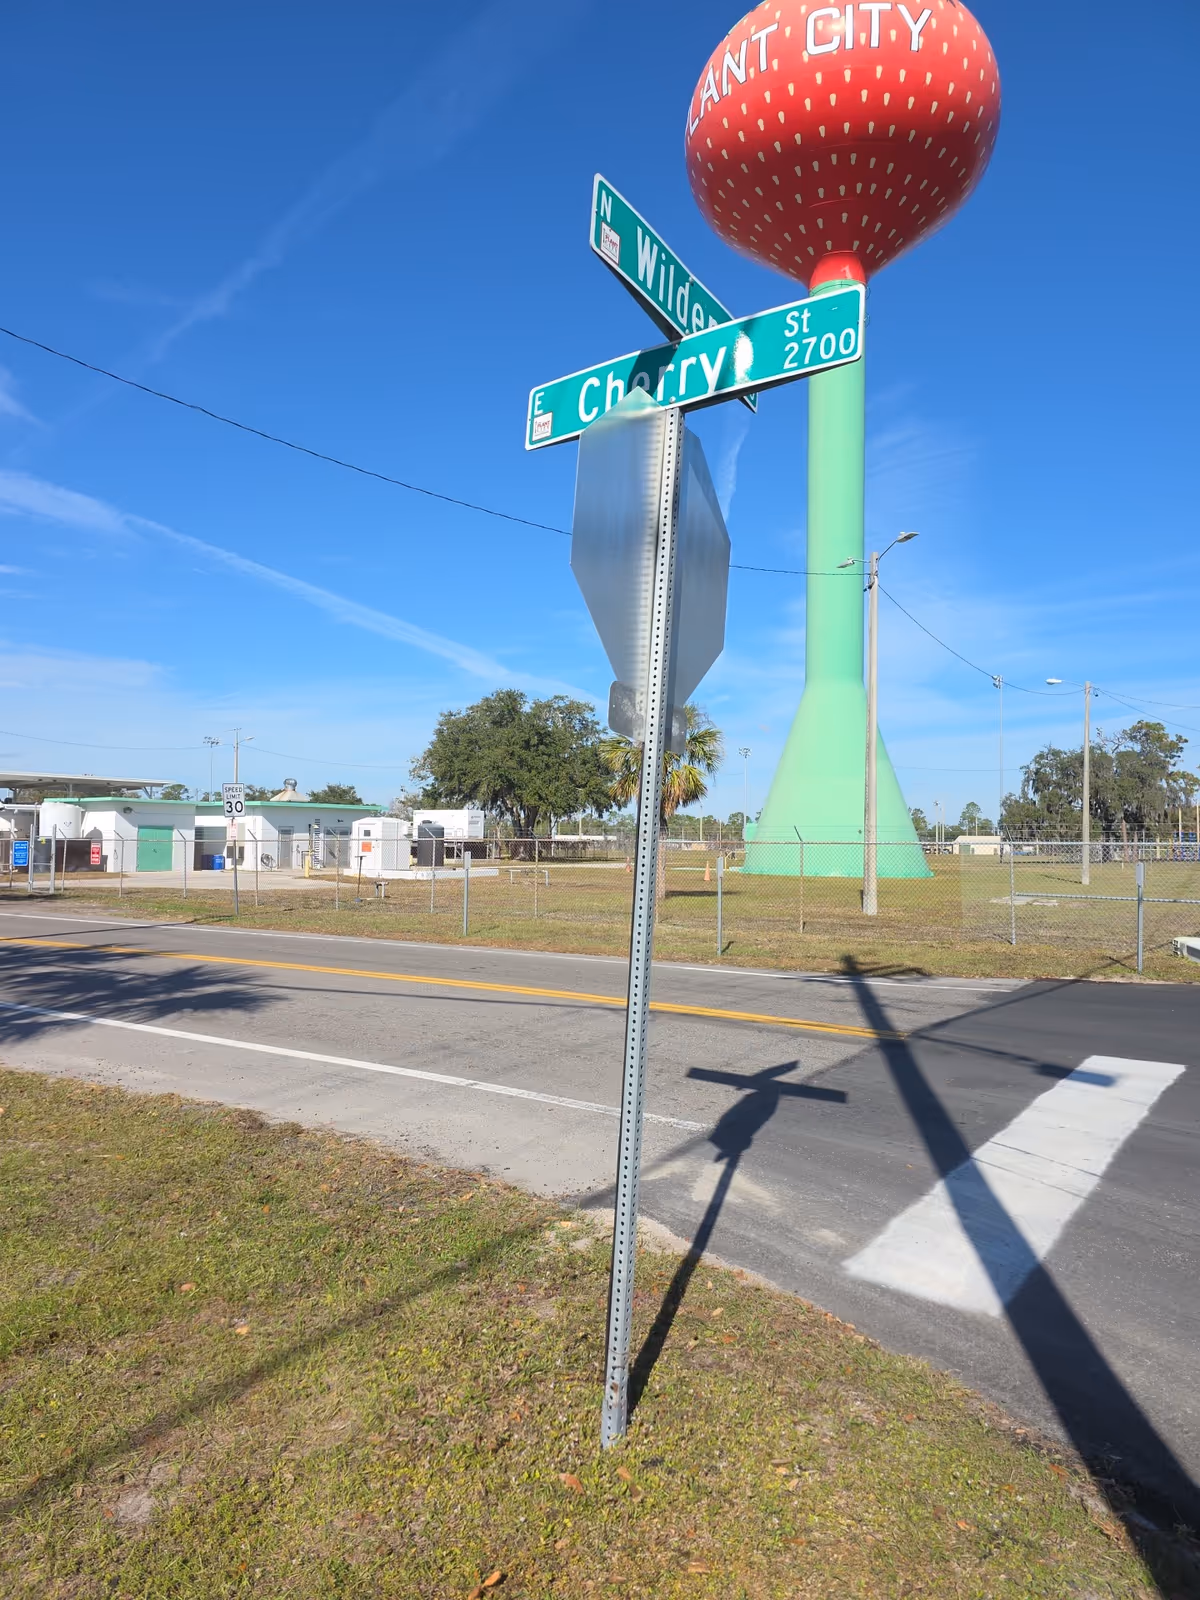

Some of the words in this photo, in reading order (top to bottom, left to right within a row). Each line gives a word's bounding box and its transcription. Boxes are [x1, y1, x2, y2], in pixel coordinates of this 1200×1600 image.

[688, 22, 779, 137] LANT
[805, 2, 932, 56] CITY
[600, 189, 612, 223] N
[534, 391, 545, 416] E
[784, 308, 811, 337] St
[783, 328, 855, 369] 2700
[226, 801, 243, 813] 30
